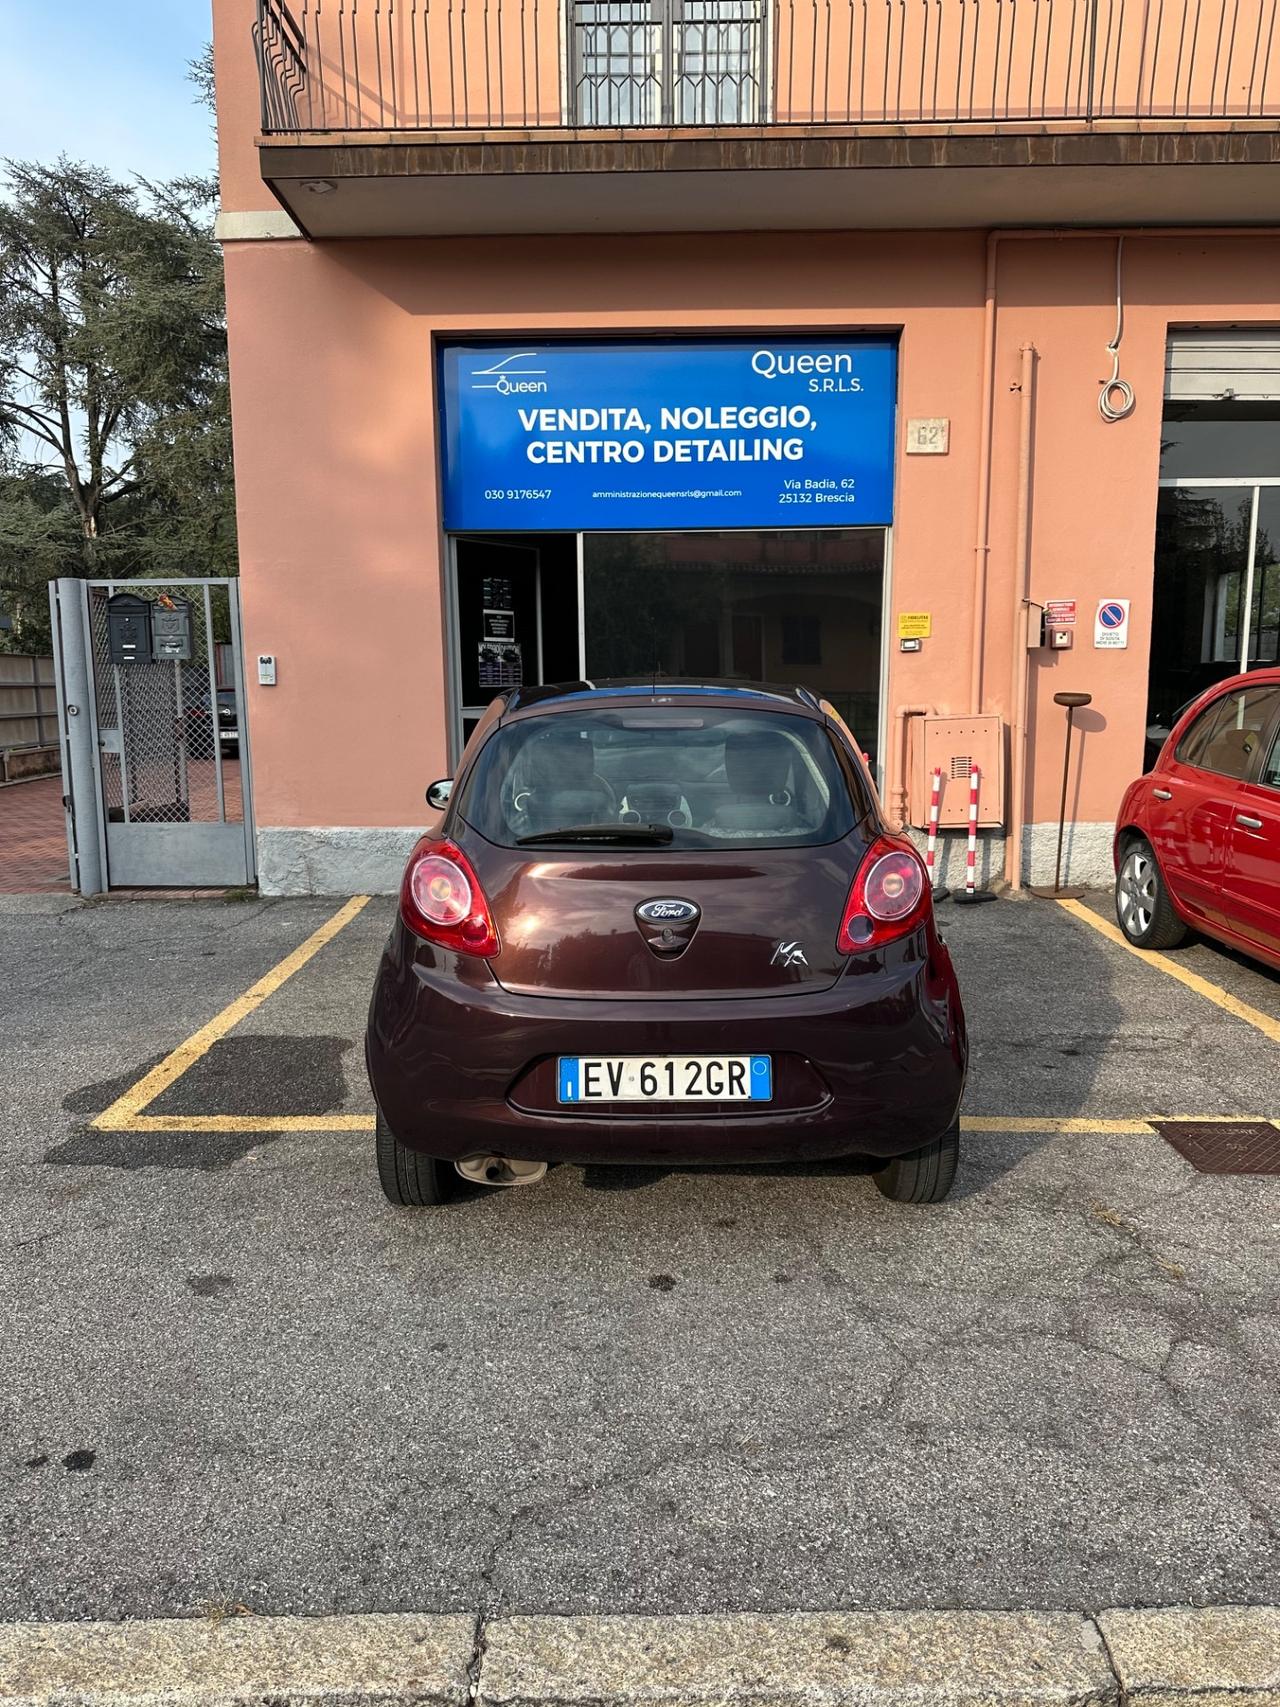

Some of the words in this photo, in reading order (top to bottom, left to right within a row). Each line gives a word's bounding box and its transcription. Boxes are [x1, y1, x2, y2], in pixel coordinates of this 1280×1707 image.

[751, 350, 852, 379] Queen
[496, 378, 547, 395] Queen
[808, 377, 864, 393] S.R.L.S.
[518, 407, 652, 434] VENDITA,
[660, 405, 817, 431] NOLEGGIO,
[526, 440, 645, 464] CENTRO
[653, 438, 804, 463] DETAILING
[784, 479, 801, 490] Via
[804, 479, 838, 491] Badia,
[840, 478, 855, 489] 62
[484, 489, 505, 500] 030
[506, 489, 552, 500] 9176547
[592, 489, 742, 500] amministrazionequeensrls@gmail.com
[778, 492, 812, 504] 25132
[815, 491, 855, 503] Brescia
[651, 904, 684, 918] Ford
[584, 1061, 624, 1097] EV
[640, 1061, 746, 1096] 612GR
